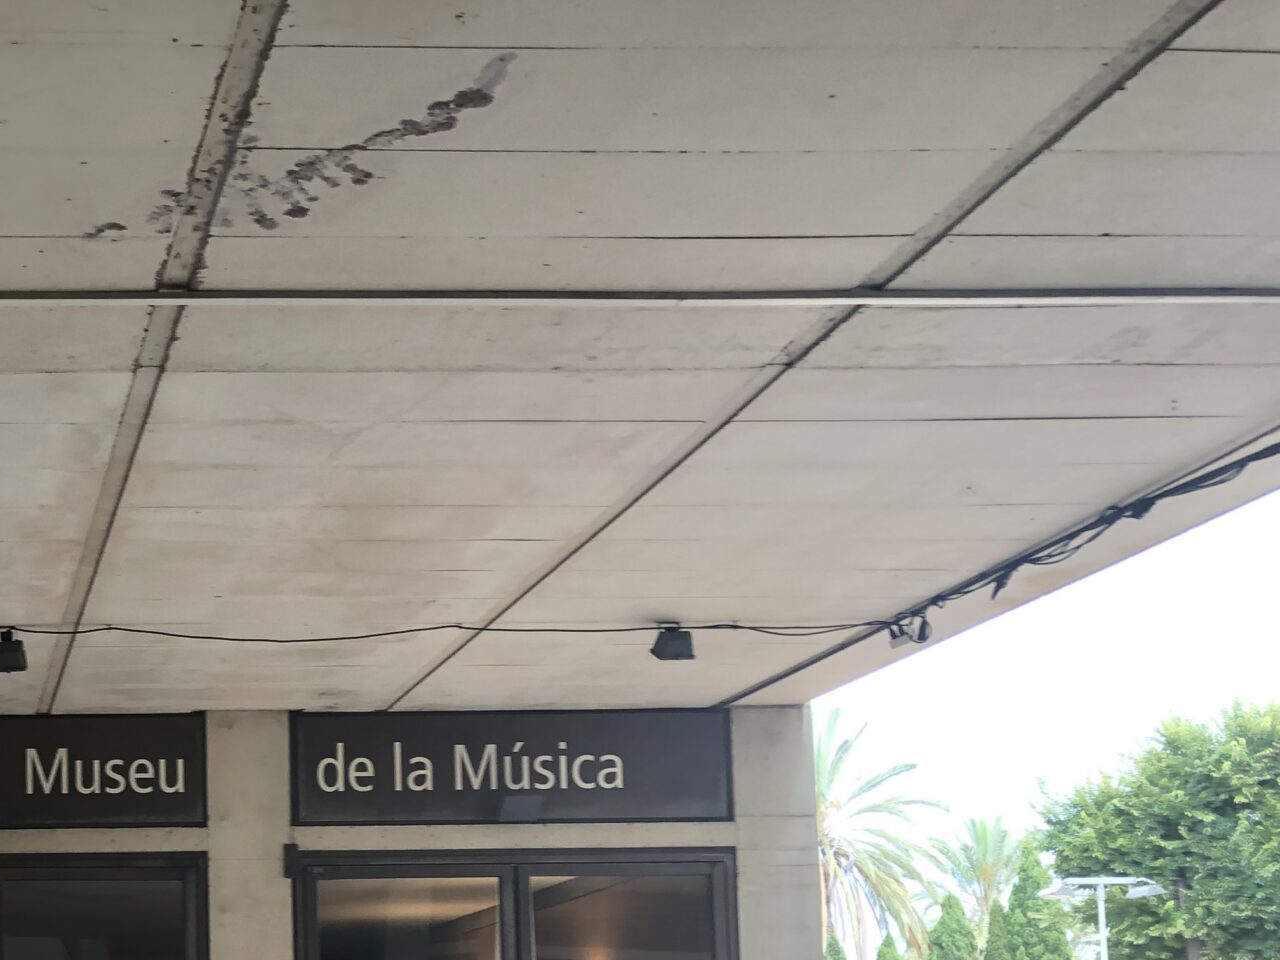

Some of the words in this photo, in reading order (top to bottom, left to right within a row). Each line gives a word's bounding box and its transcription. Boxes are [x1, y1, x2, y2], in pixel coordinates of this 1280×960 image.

[26, 747, 185, 795] Museu
[316, 743, 375, 793] de
[393, 742, 434, 792] la
[454, 742, 625, 791] Música
